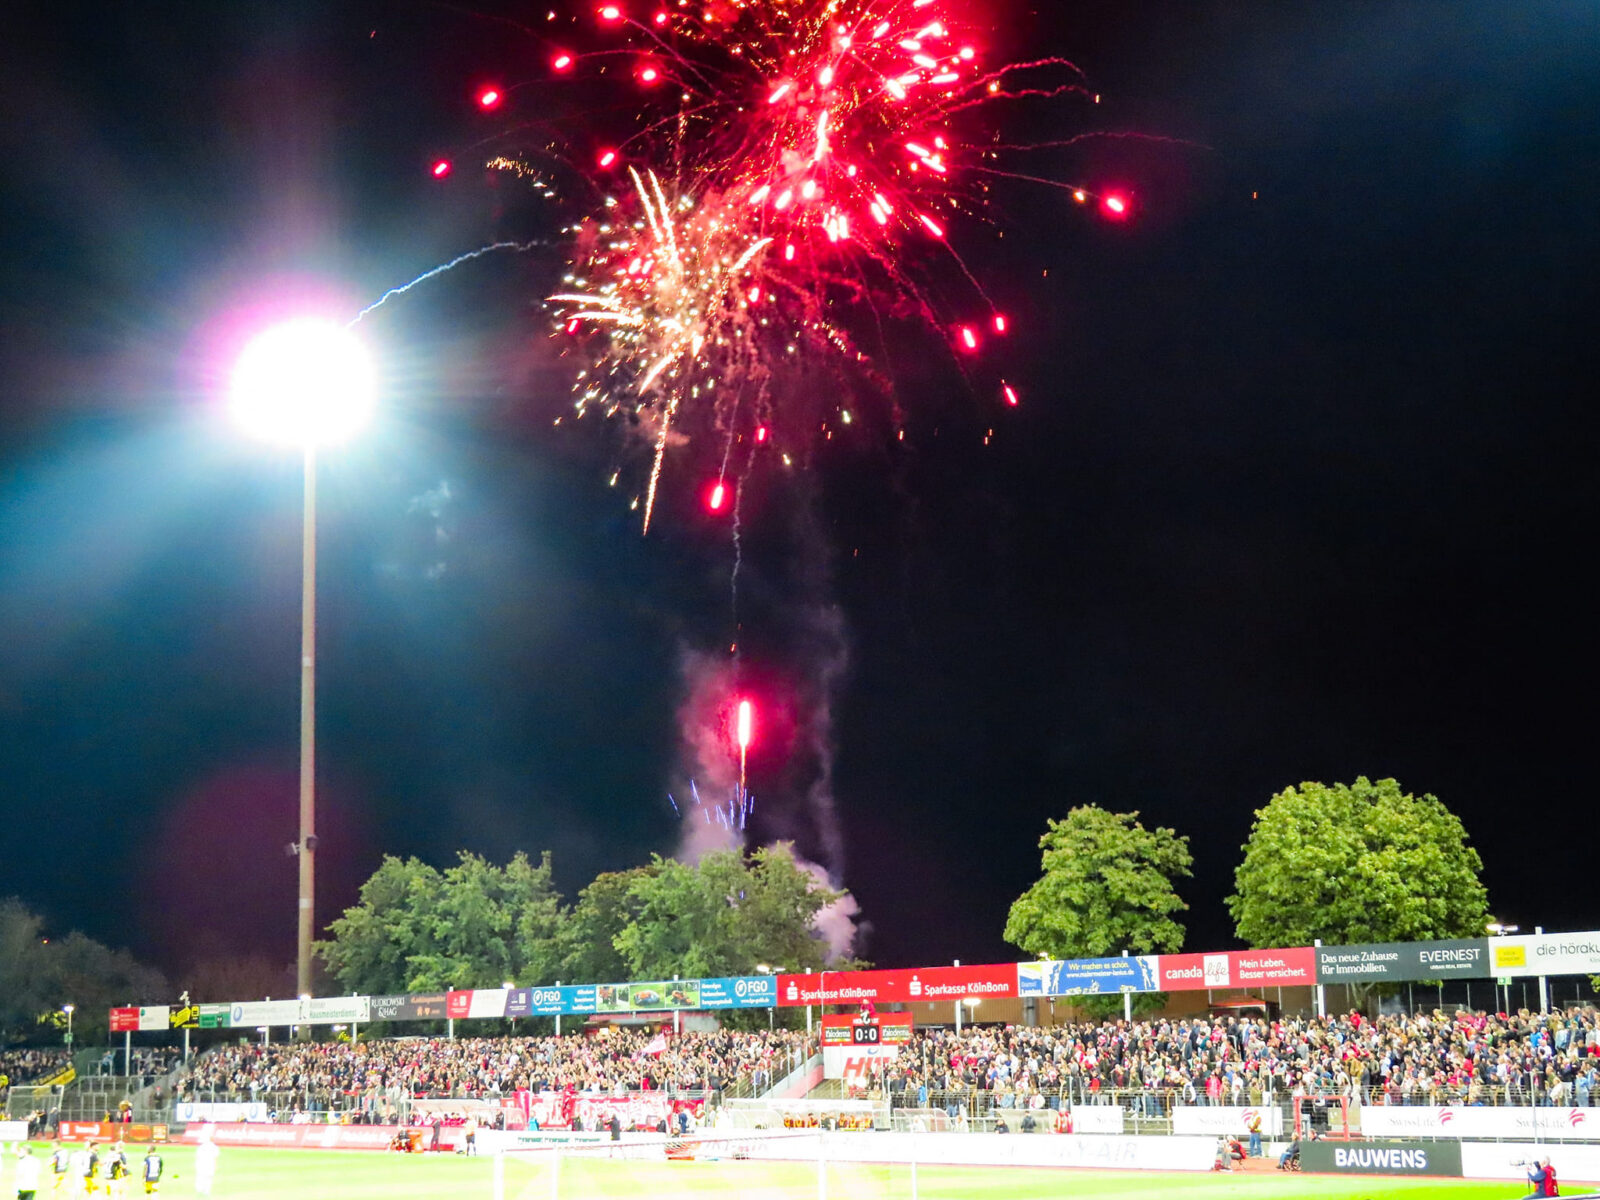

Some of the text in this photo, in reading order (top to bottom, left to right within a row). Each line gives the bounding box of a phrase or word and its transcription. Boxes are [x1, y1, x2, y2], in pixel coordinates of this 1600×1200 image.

[1420, 948, 1480, 963] EVERNEST
[1537, 944, 1556, 956] die
[1239, 958, 1286, 968] Mein Leben.
[1321, 951, 1398, 963] Das neue Zuhause
[1166, 962, 1229, 982] canada life
[1239, 967, 1307, 979] Besser versichert.
[1322, 963, 1387, 975] für Immobilien.
[748, 980, 768, 992] FGO
[924, 984, 966, 998] Sparkasse
[967, 982, 1009, 993] KölnBonn
[543, 991, 561, 1002] FGO
[801, 987, 877, 1001] Sparkasse KölnBonn
[855, 1028, 878, 1041] 0:0
[1334, 1148, 1427, 1169] BAUWENS
